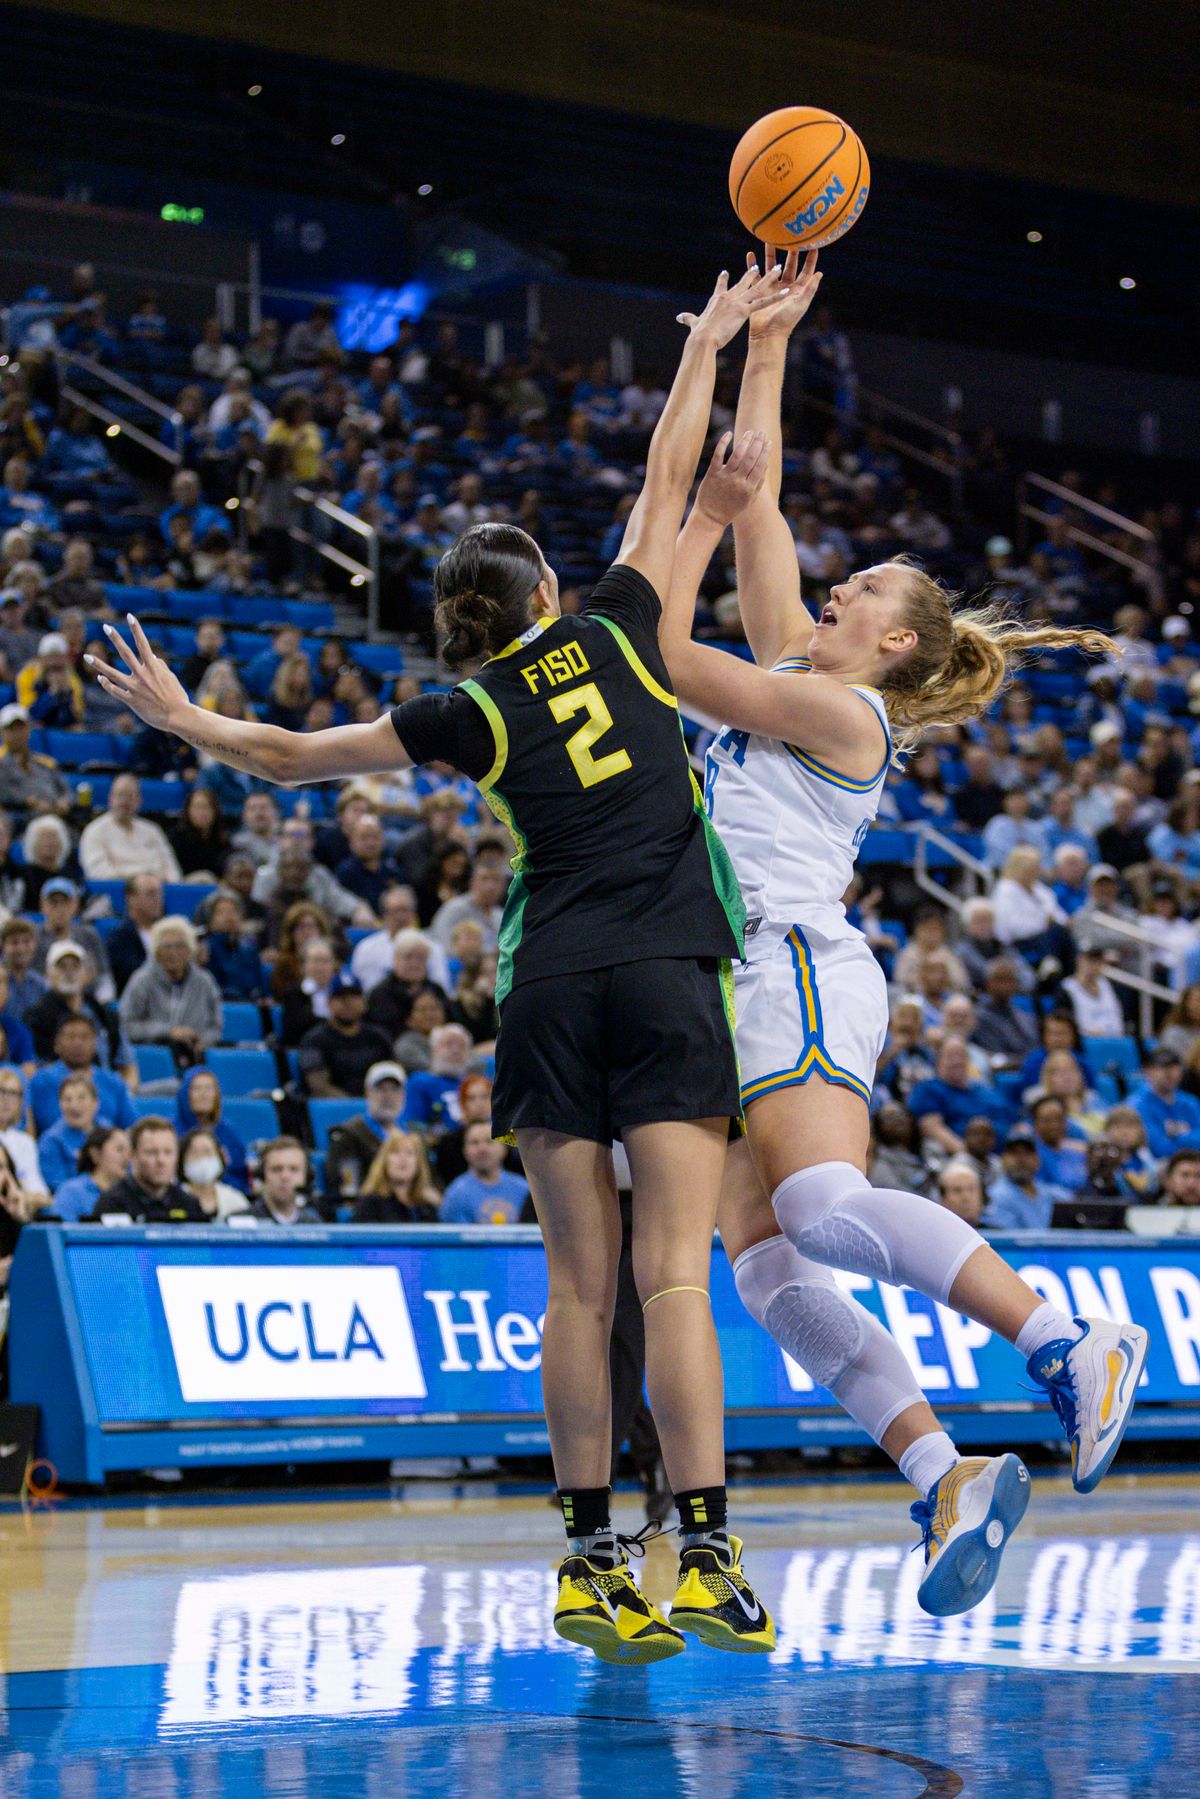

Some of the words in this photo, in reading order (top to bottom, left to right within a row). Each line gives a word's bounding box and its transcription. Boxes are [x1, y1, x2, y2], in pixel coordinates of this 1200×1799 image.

[784, 175, 846, 236] NCAA
[519, 640, 591, 695] FISO
[547, 682, 633, 789] 2
[204, 1301, 386, 1364] UCLA
[423, 1290, 547, 1373] He
